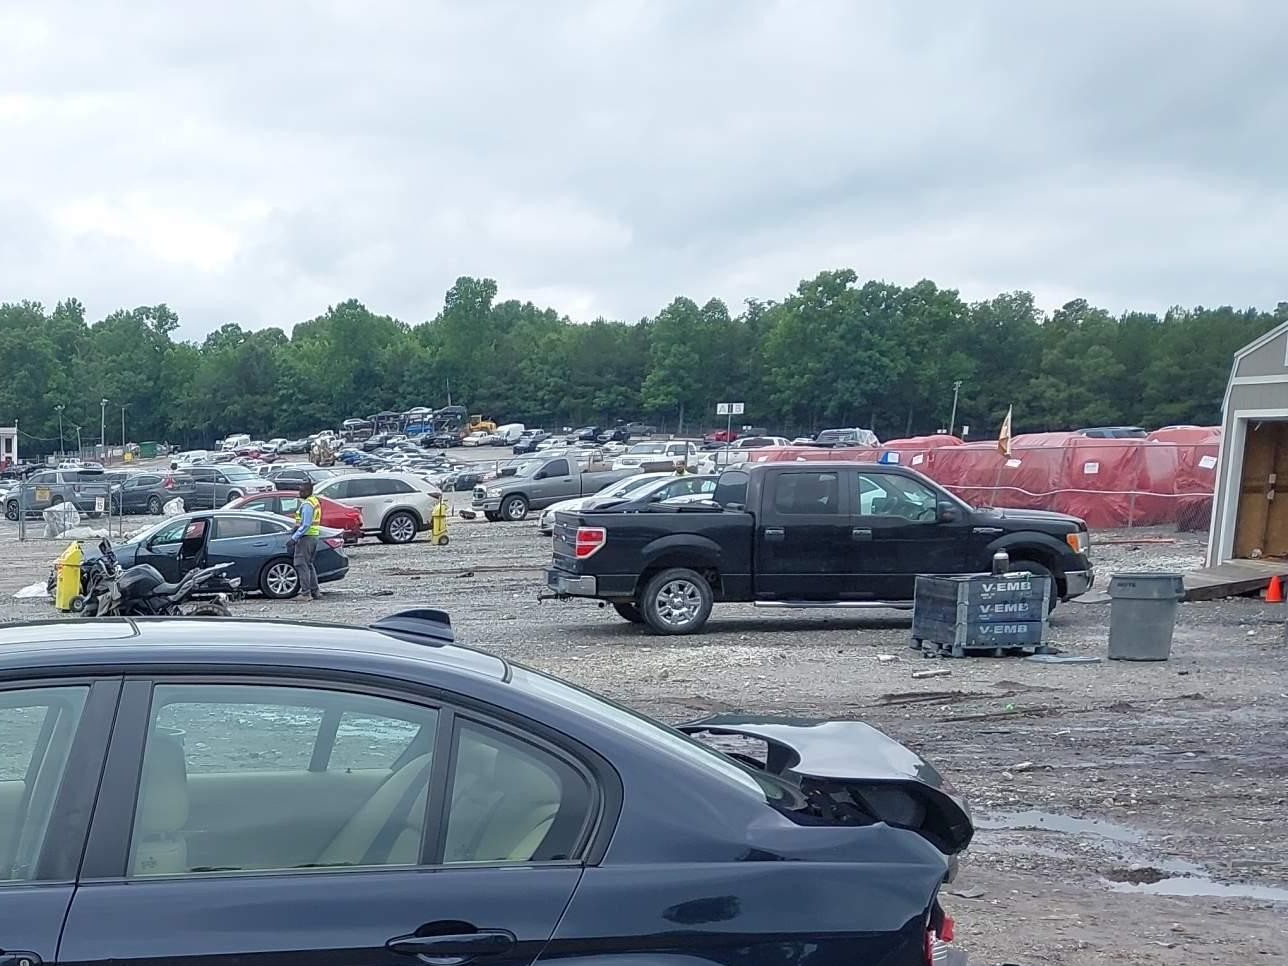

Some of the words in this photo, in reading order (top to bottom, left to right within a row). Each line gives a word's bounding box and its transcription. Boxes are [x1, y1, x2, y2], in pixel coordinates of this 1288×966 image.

[982, 581, 1031, 592] V-EMB
[979, 603, 1029, 613] V-EMB
[979, 624, 1027, 634] V-EMB
